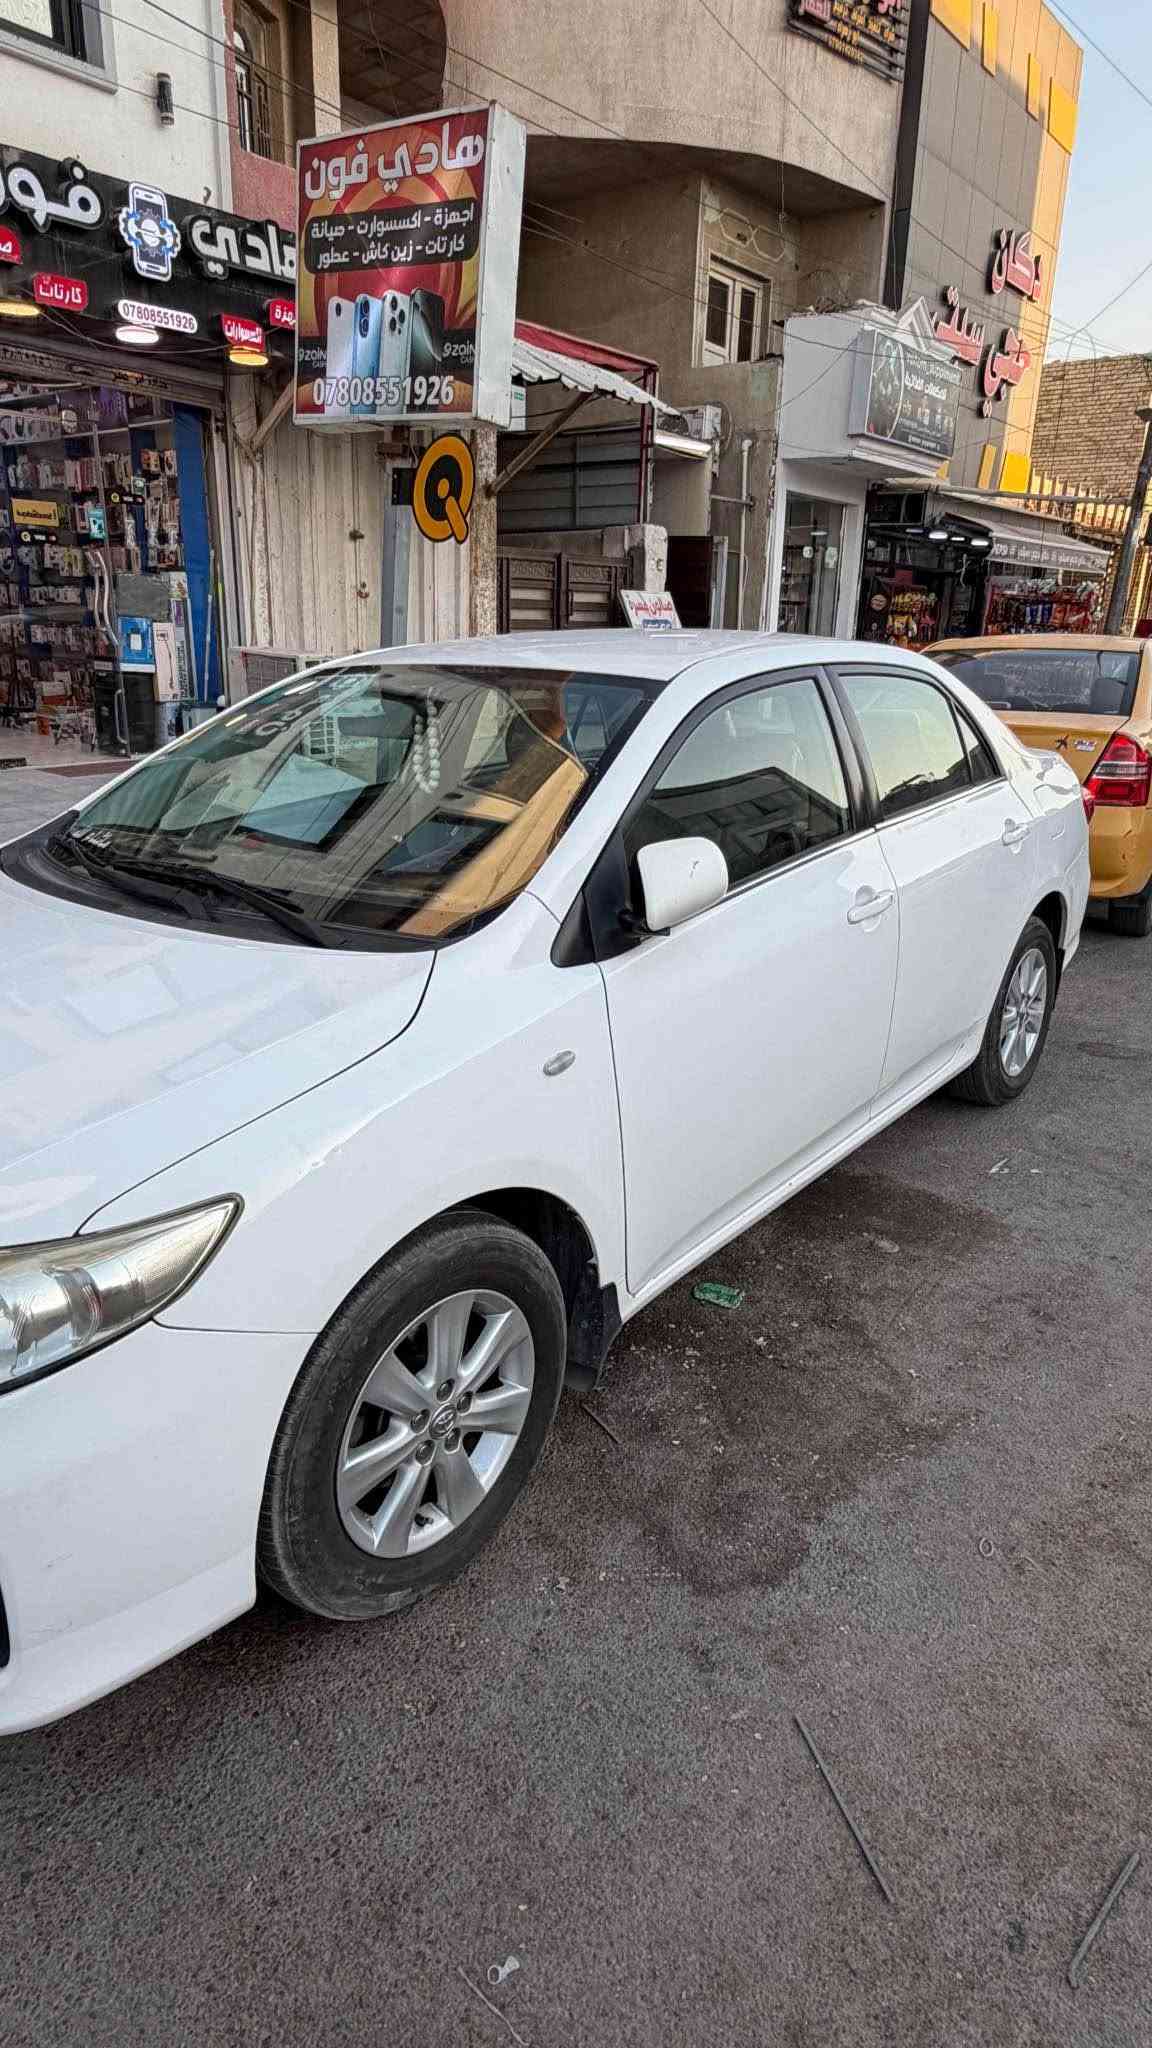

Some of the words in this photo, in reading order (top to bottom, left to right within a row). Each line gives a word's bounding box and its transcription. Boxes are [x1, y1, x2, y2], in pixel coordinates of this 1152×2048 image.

[304, 139, 369, 200] فون
[377, 122, 485, 193] هادي
[0, 164, 102, 228] فو
[433, 202, 474, 229] اجهزة
[311, 221, 345, 241] صيانة
[317, 246, 350, 269] عطور
[362, 240, 390, 264] كاش
[391, 239, 413, 261] زين
[122, 302, 195, 331] 07808551926
[313, 374, 454, 406] 07808551926
